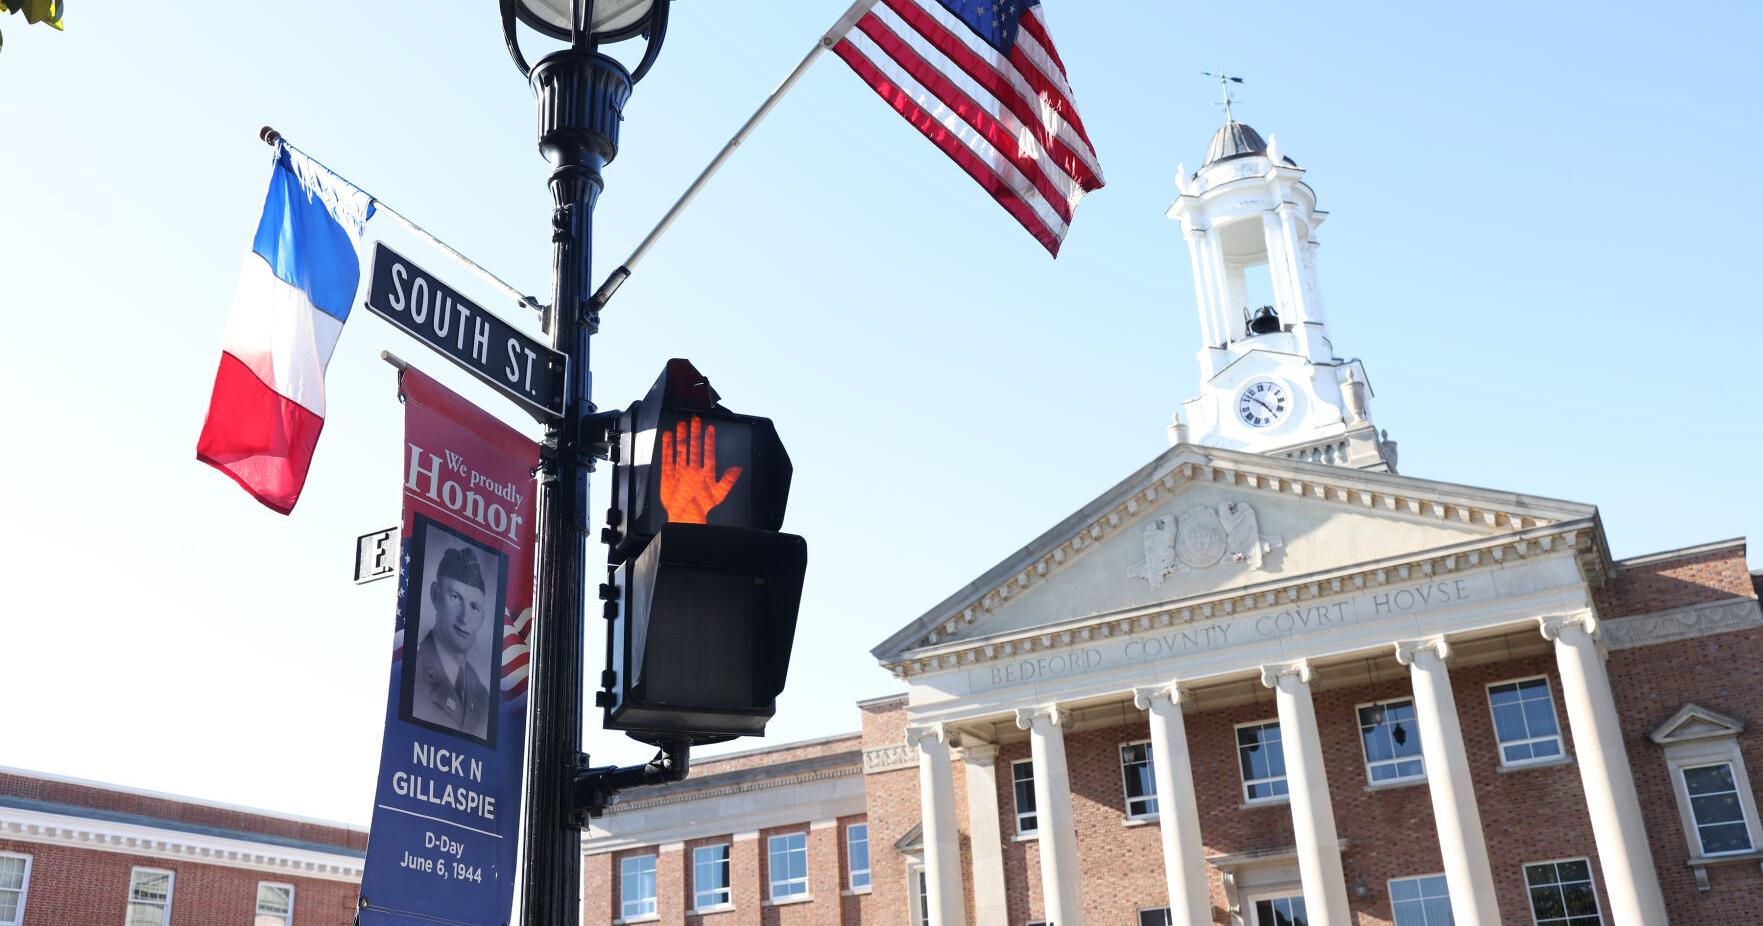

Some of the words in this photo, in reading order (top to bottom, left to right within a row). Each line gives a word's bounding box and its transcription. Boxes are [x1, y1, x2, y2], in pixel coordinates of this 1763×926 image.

[388, 262, 489, 365] SOUTH
[505, 338, 537, 396] ST.
[405, 443, 524, 541] Honor
[444, 449, 467, 477] We
[470, 470, 524, 510] proudly
[991, 648, 1103, 685] BEDFORD
[1124, 622, 1231, 658] COVNTY
[1255, 600, 1349, 637] COVRT
[1373, 579, 1470, 615] HOVSE
[412, 741, 465, 777] NICK
[470, 758, 483, 783] N
[392, 771, 496, 820] GILLASPIE
[400, 851, 433, 873] June
[436, 859, 448, 879] 6,
[453, 862, 482, 884] 1944
[425, 831, 464, 859] D-Day
